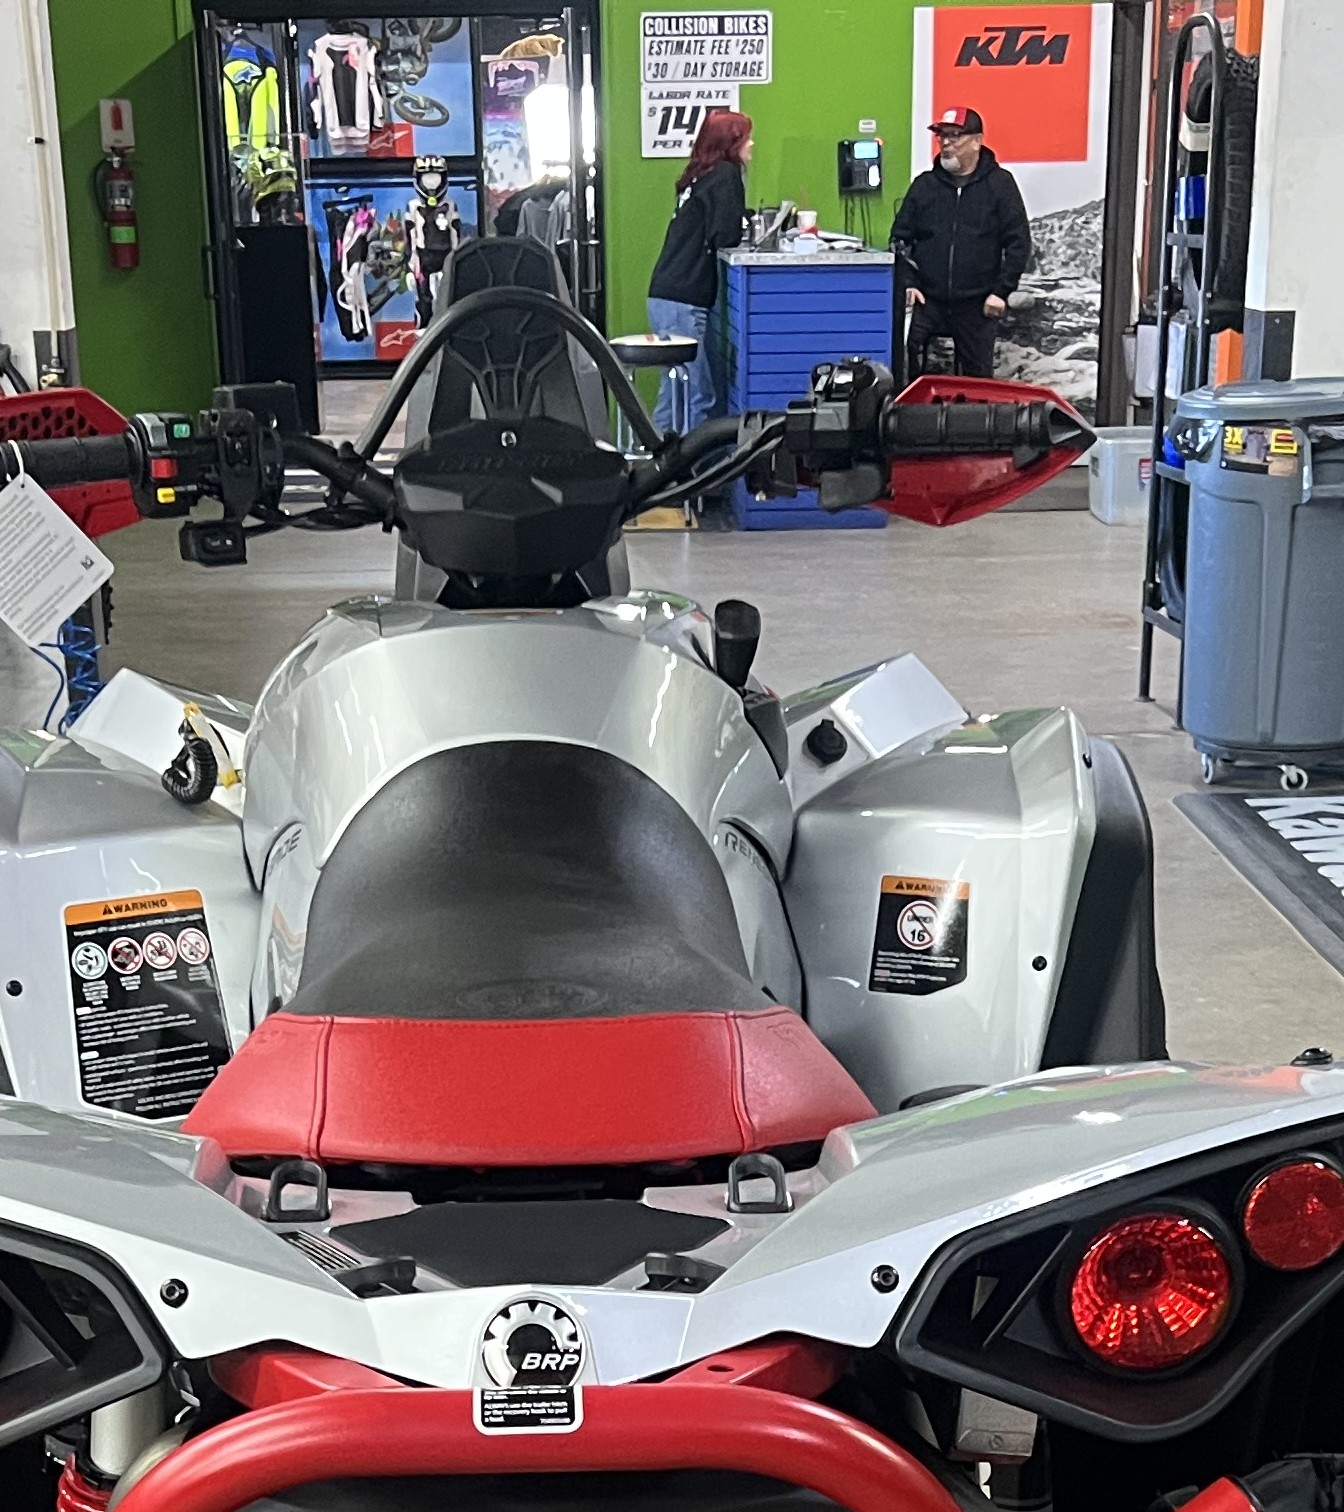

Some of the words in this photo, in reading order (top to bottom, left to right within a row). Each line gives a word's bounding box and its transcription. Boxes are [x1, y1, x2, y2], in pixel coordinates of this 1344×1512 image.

[644, 16, 719, 35] COLLISION
[724, 16, 767, 35] BIKES
[648, 39, 706, 56] ESTIMATE
[710, 39, 732, 55] FEE
[735, 38, 764, 55] $250
[954, 25, 1070, 67] KTM
[683, 62, 706, 78] DAY
[710, 61, 764, 78] STORAGE
[648, 91, 691, 100] LABOR
[696, 90, 730, 99] RATE
[652, 140, 682, 149] PER
[112, 898, 168, 913] WARNING
[910, 928, 926, 942] 16
[521, 1352, 580, 1371] BRP
